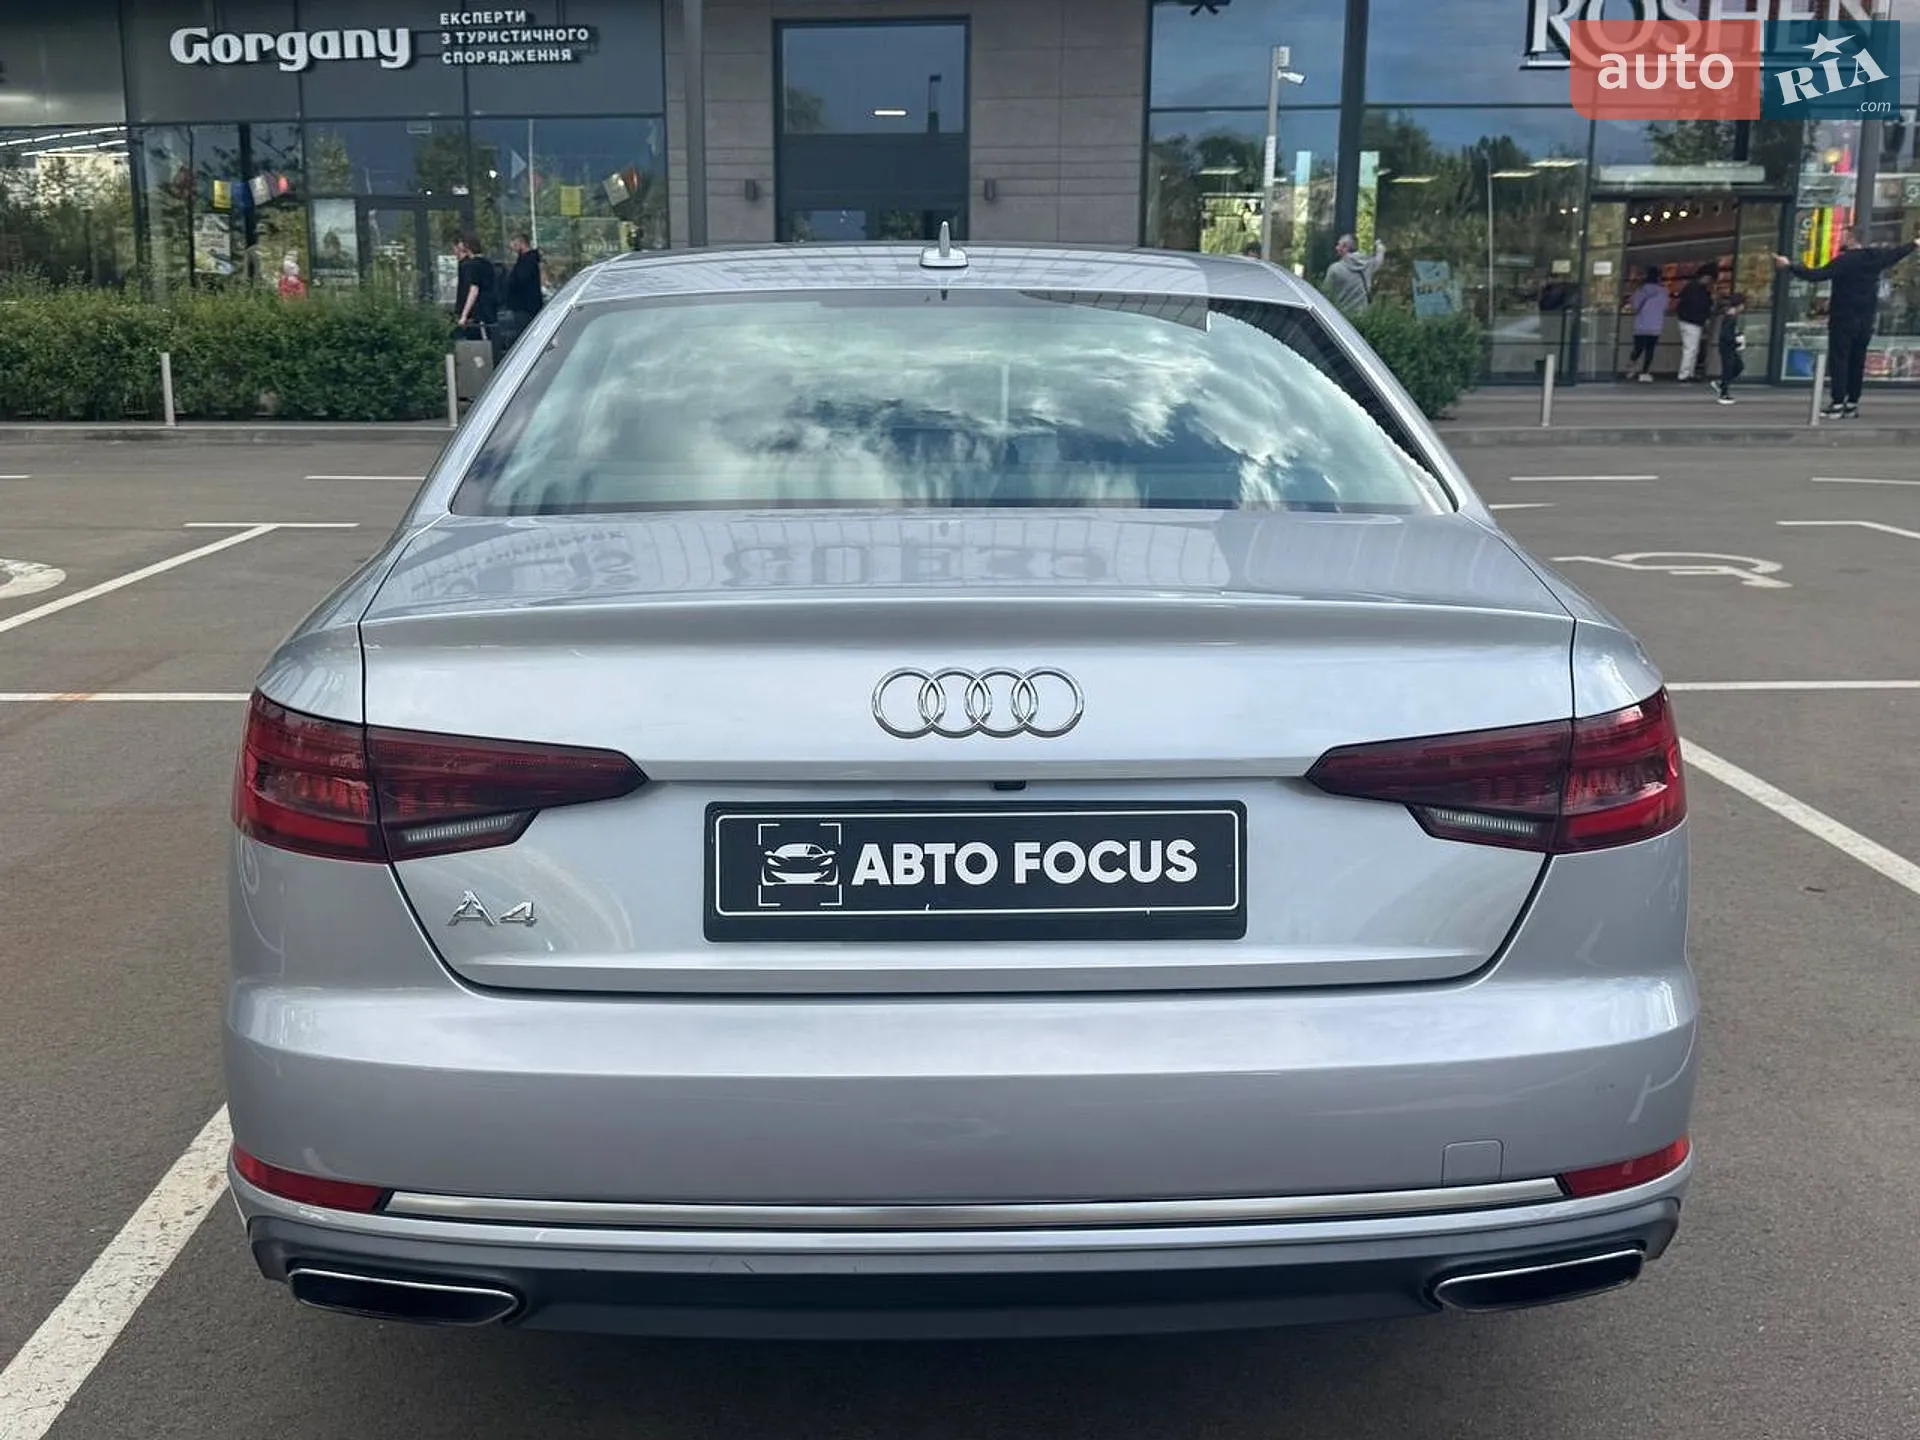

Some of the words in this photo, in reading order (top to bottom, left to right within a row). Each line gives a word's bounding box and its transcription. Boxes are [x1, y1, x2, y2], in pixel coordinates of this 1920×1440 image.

[440, 10, 526, 25] ЕКСПЕРТИ
[456, 28, 589, 43] ТУРИСТИЧНОГО
[170, 27, 410, 72] Gorgany
[442, 49, 572, 64] СПОРЯДЖЕННЯ
[1014, 839, 1197, 884] FOCUS
[447, 890, 538, 927] A4
